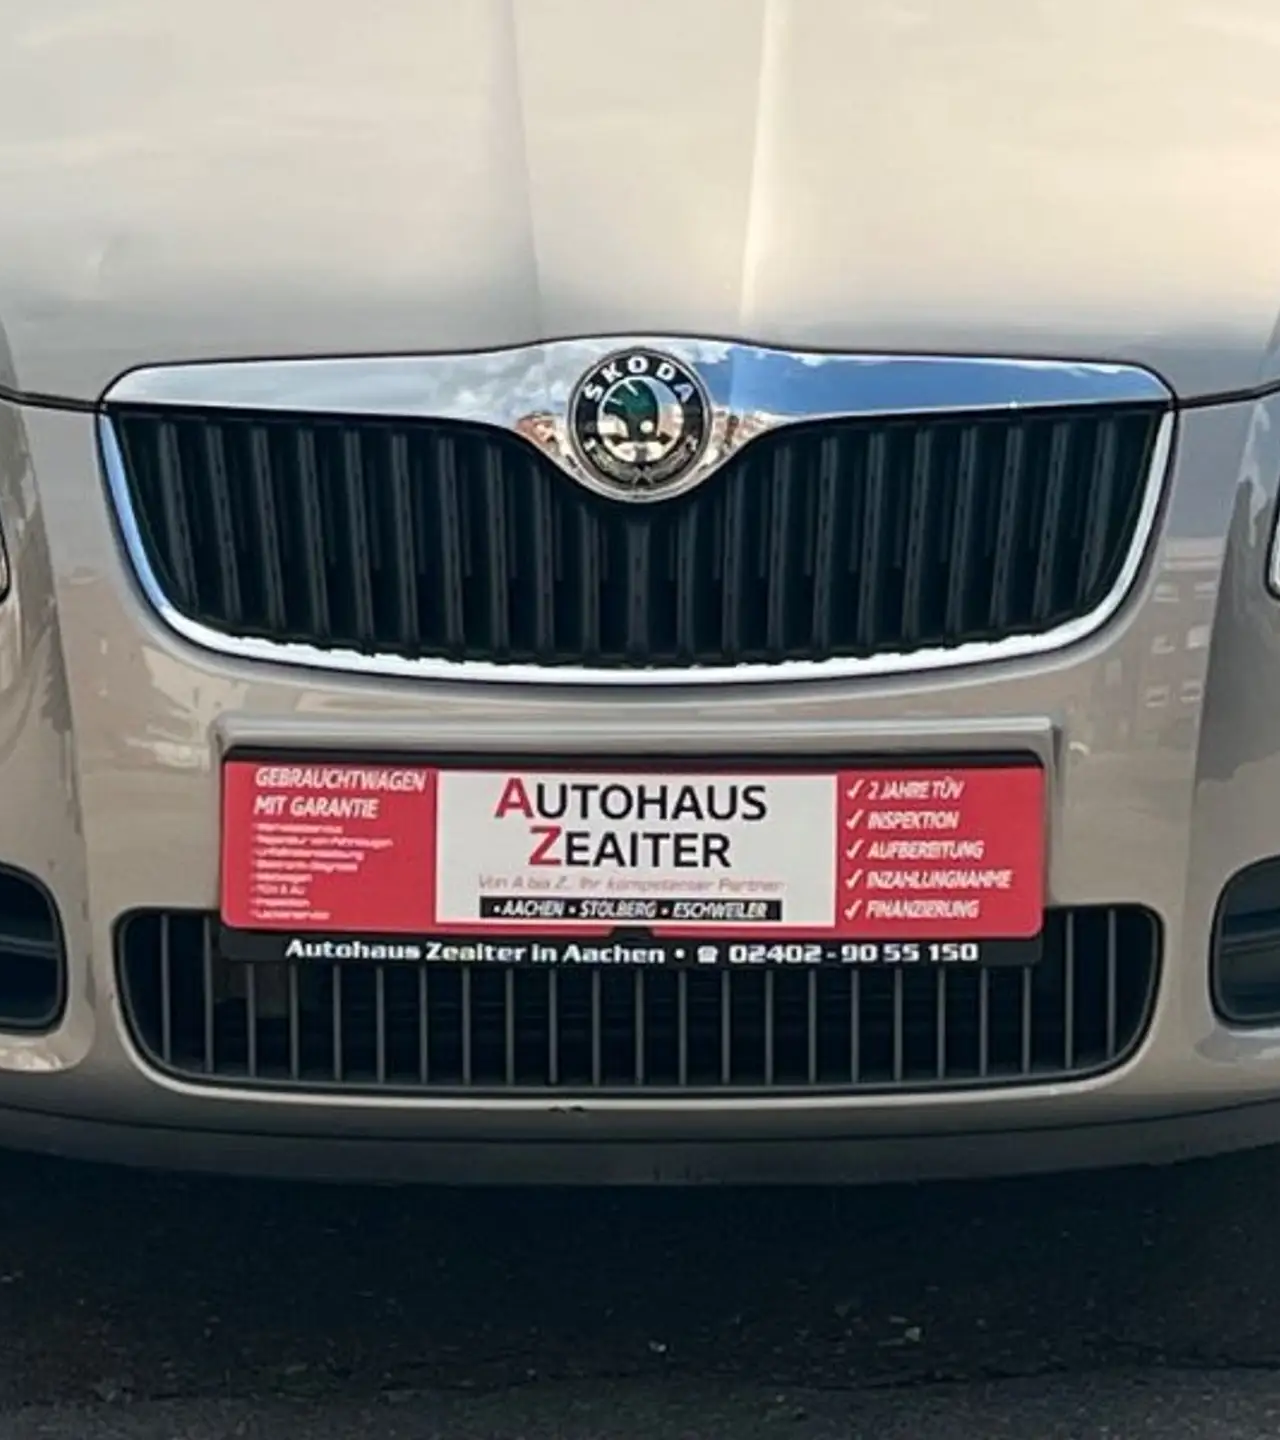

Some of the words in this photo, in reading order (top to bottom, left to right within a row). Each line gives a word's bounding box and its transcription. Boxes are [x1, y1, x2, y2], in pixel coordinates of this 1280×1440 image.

[254, 767, 426, 792] GEBRAUCHTWAGEN
[868, 781, 879, 800] 2
[881, 781, 930, 799] JAHRE
[932, 776, 965, 799] TÜV
[253, 795, 287, 817] MIT
[290, 796, 380, 819] GARANTIE
[494, 777, 767, 820] AUTOHAUS
[868, 811, 960, 829] INSPEKTION
[528, 825, 731, 868] ZEAITER
[867, 840, 984, 860] AUFBEREITUNG
[502, 900, 564, 917] AACHEN
[579, 901, 658, 918] STOLBERG
[672, 902, 768, 918] ESCHWEILER
[866, 899, 980, 918] FINANZIERUNG
[285, 939, 420, 960] Autohaus
[425, 942, 527, 962] Zeaiter
[531, 943, 561, 963] in
[563, 943, 665, 964] Aachen
[883, 943, 921, 962] 55
[927, 942, 980, 962] 150
